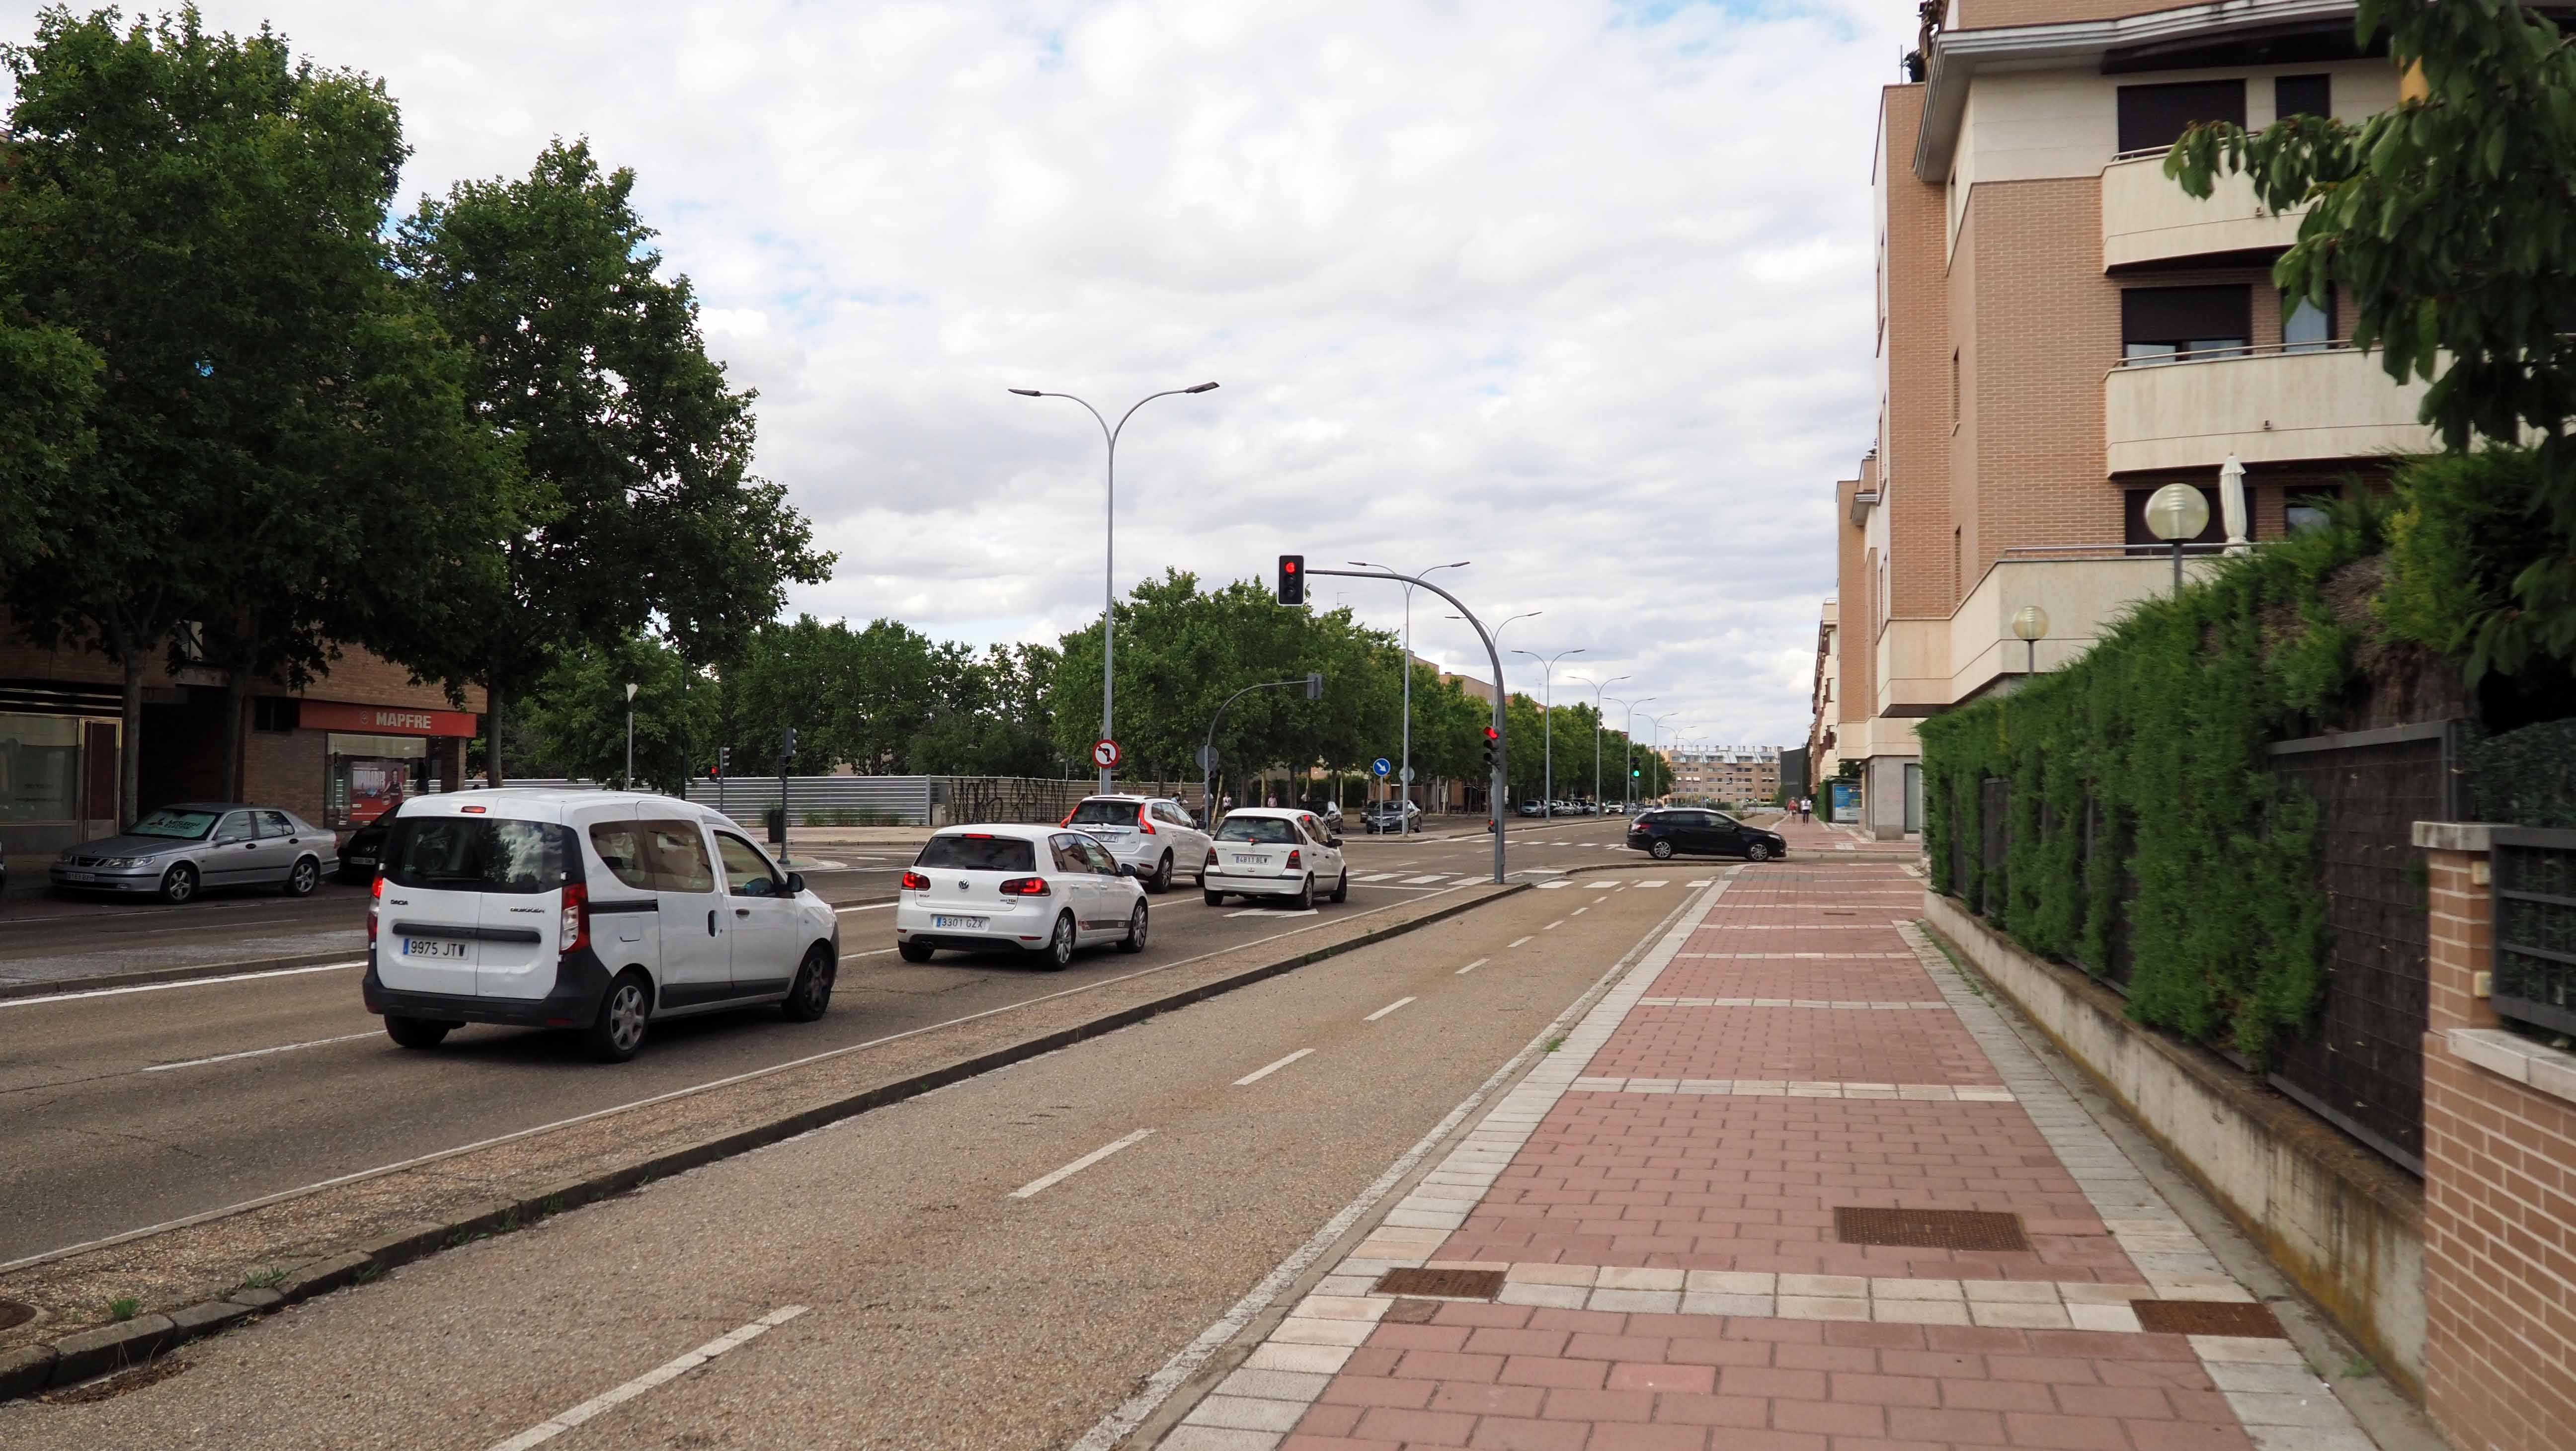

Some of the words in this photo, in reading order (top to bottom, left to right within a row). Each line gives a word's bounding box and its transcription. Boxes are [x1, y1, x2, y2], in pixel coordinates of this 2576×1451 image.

[376, 712, 431, 729] MAPFRE
[942, 918, 963, 927] 3301
[966, 919, 983, 928] GZX
[411, 941, 438, 955] 9975
[443, 944, 466, 957] JTW
